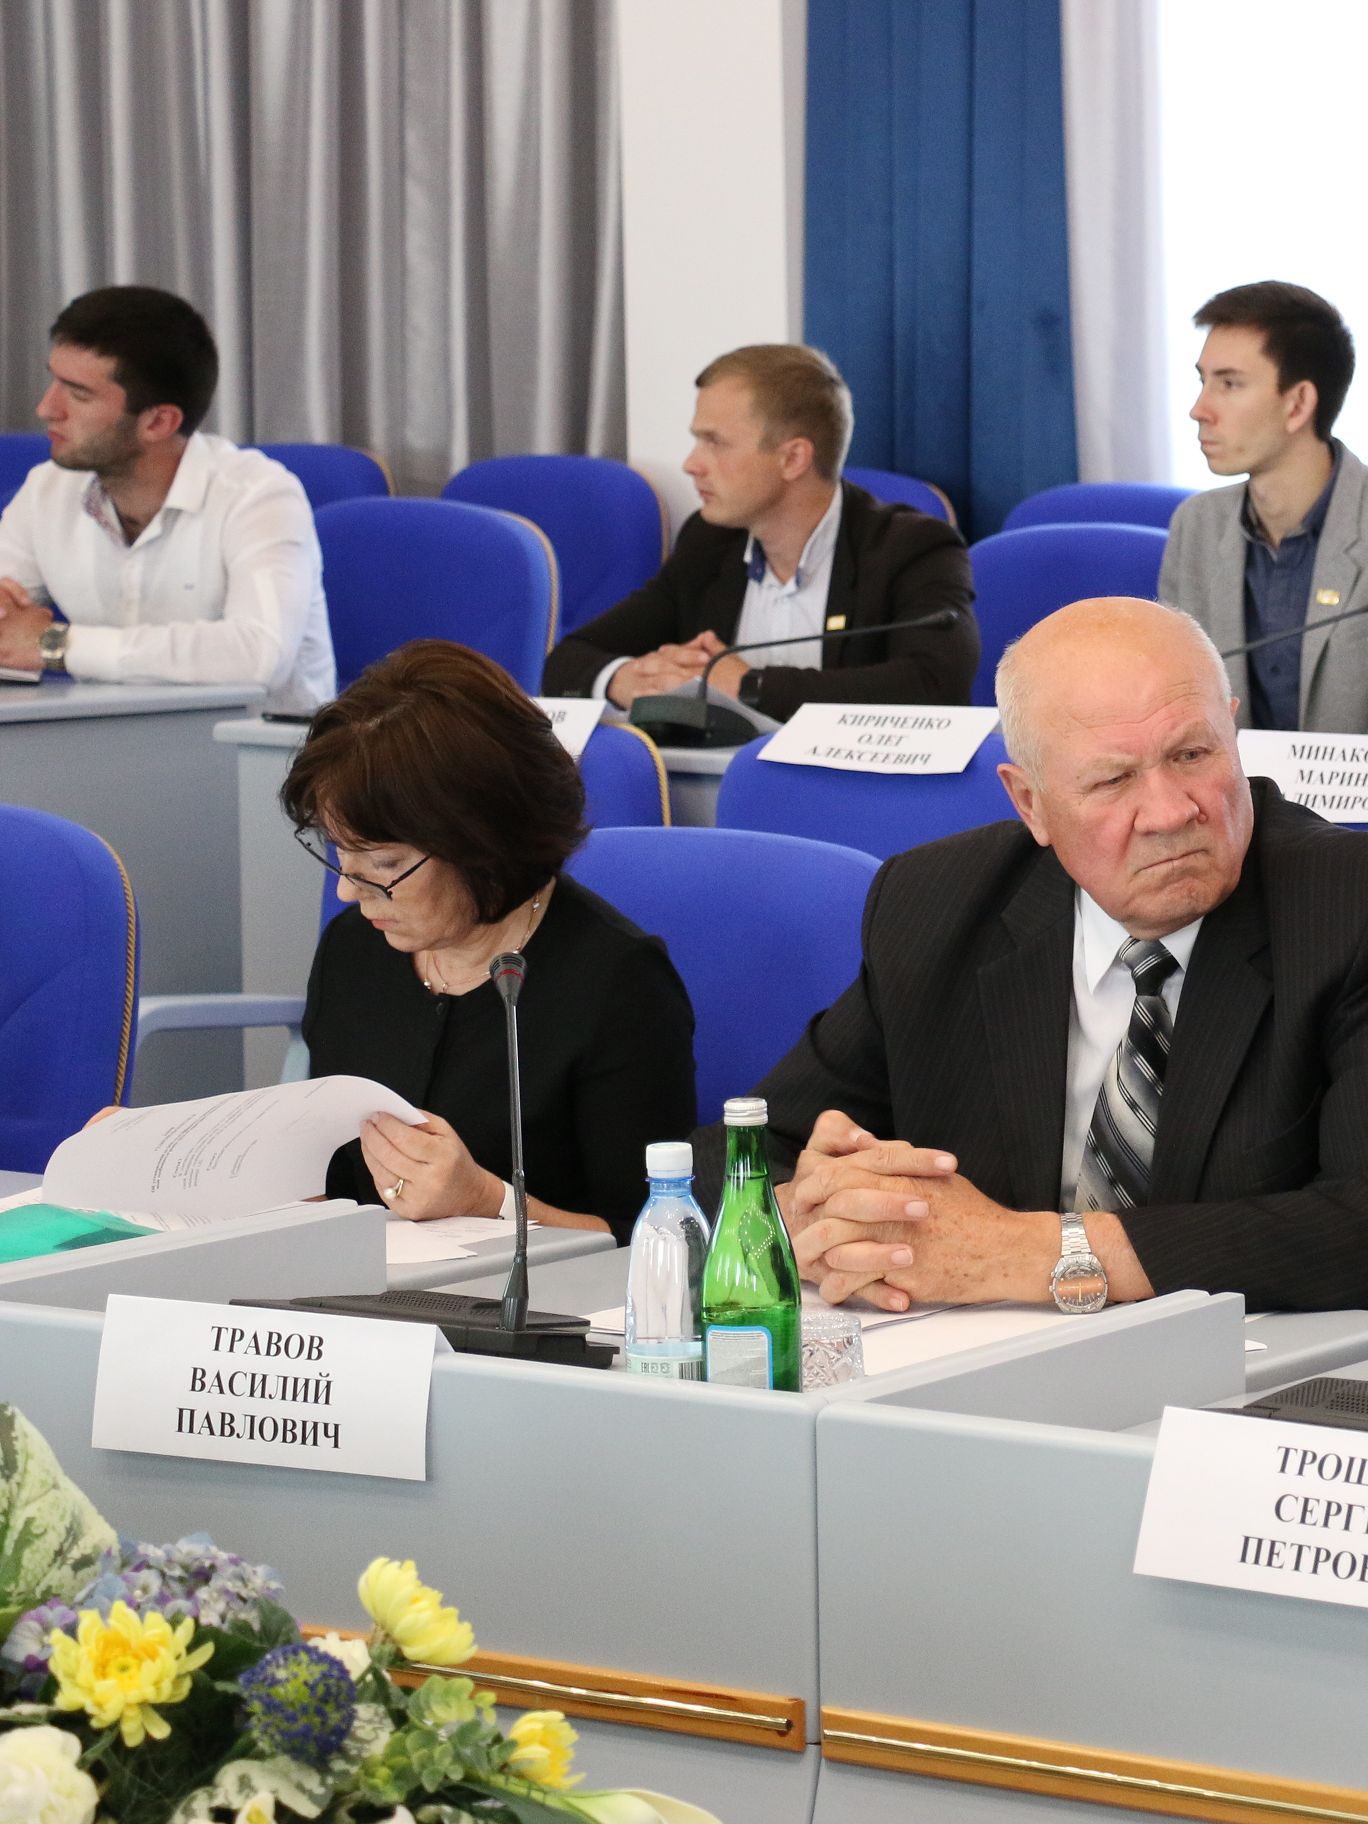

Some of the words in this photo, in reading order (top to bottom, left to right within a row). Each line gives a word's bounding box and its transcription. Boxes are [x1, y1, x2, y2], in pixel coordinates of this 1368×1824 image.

[837, 713, 951, 730] КИРИЧЕНКО
[857, 733, 907, 747] ОЛЕГ
[808, 747, 931, 766] АЛЕКСЕЕВИЧ
[211, 1326, 324, 1361] ТРАВОВ
[189, 1366, 333, 1405] ВАСИЛИЙ
[175, 1408, 342, 1449] ПАВЛОВИЧ
